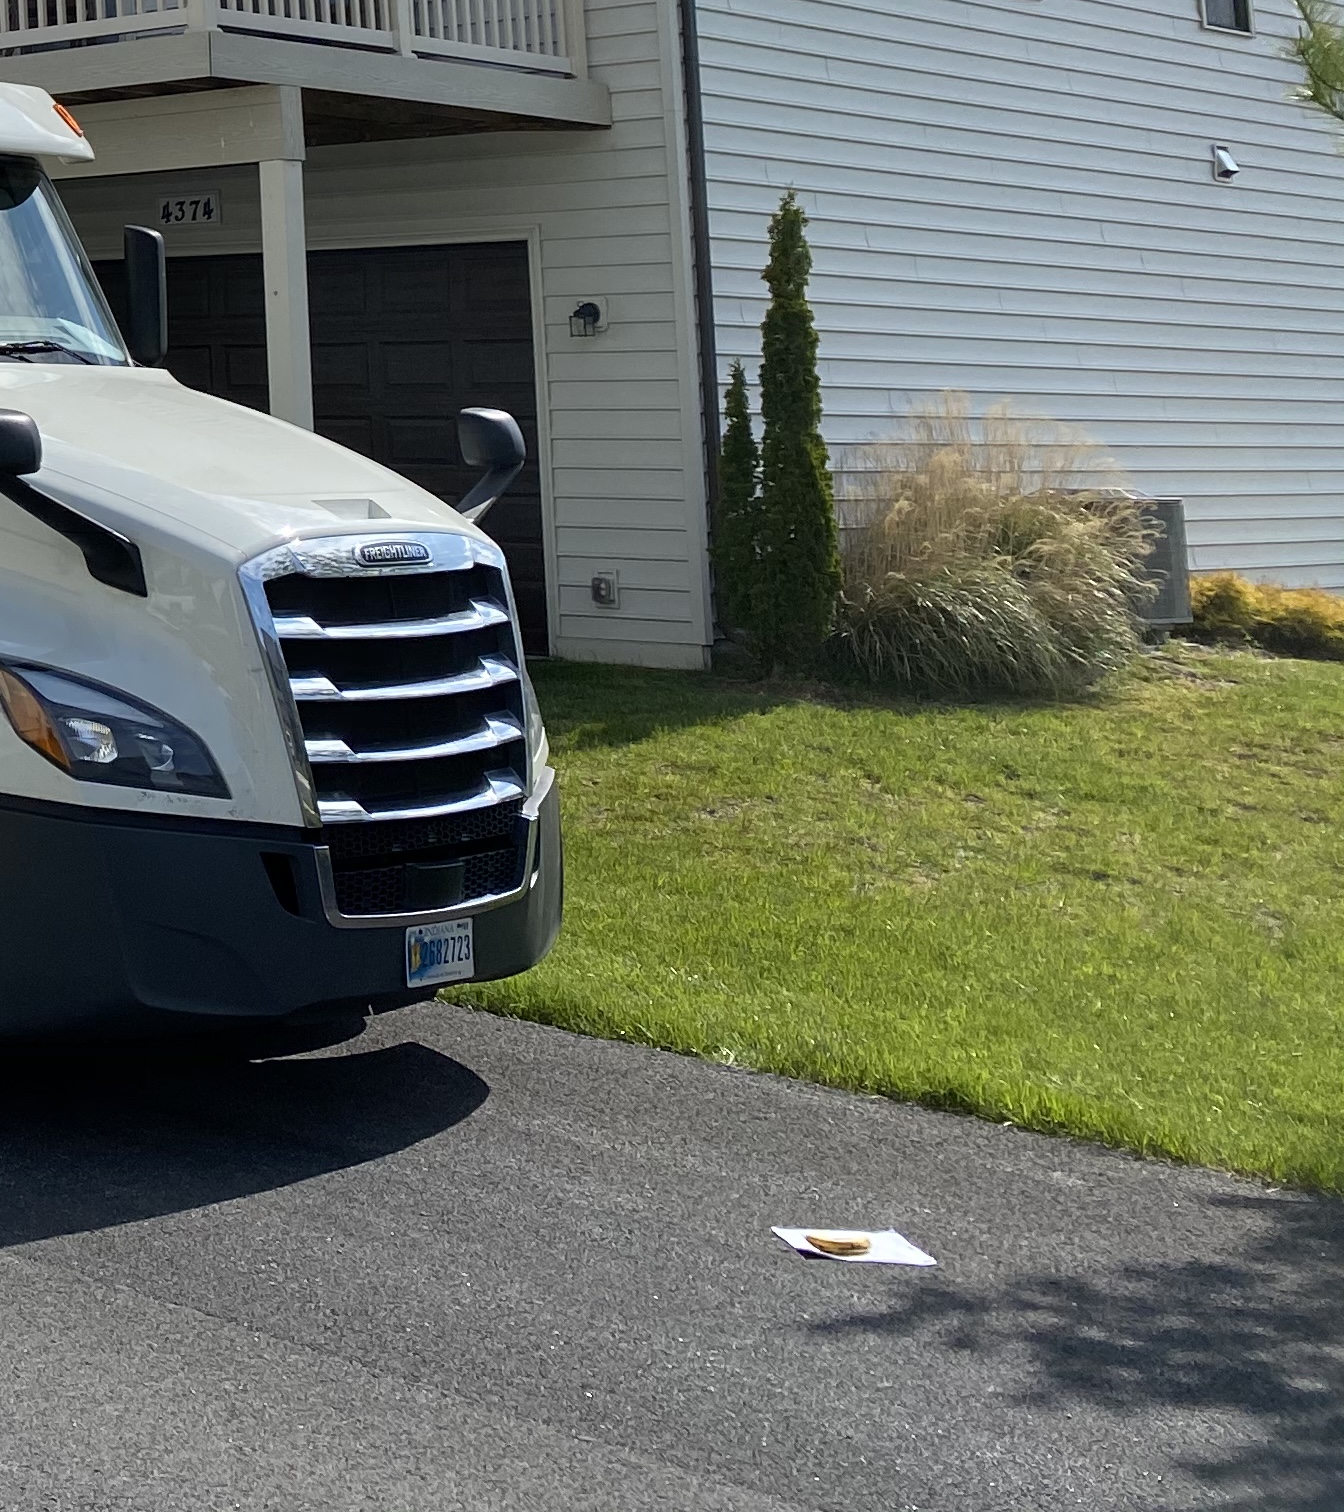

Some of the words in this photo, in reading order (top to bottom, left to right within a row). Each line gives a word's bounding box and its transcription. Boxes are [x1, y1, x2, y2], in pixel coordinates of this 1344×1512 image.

[160, 197, 215, 224] 4374
[364, 545, 426, 560] FREIGHTLINER
[422, 935, 470, 968] 2682723
